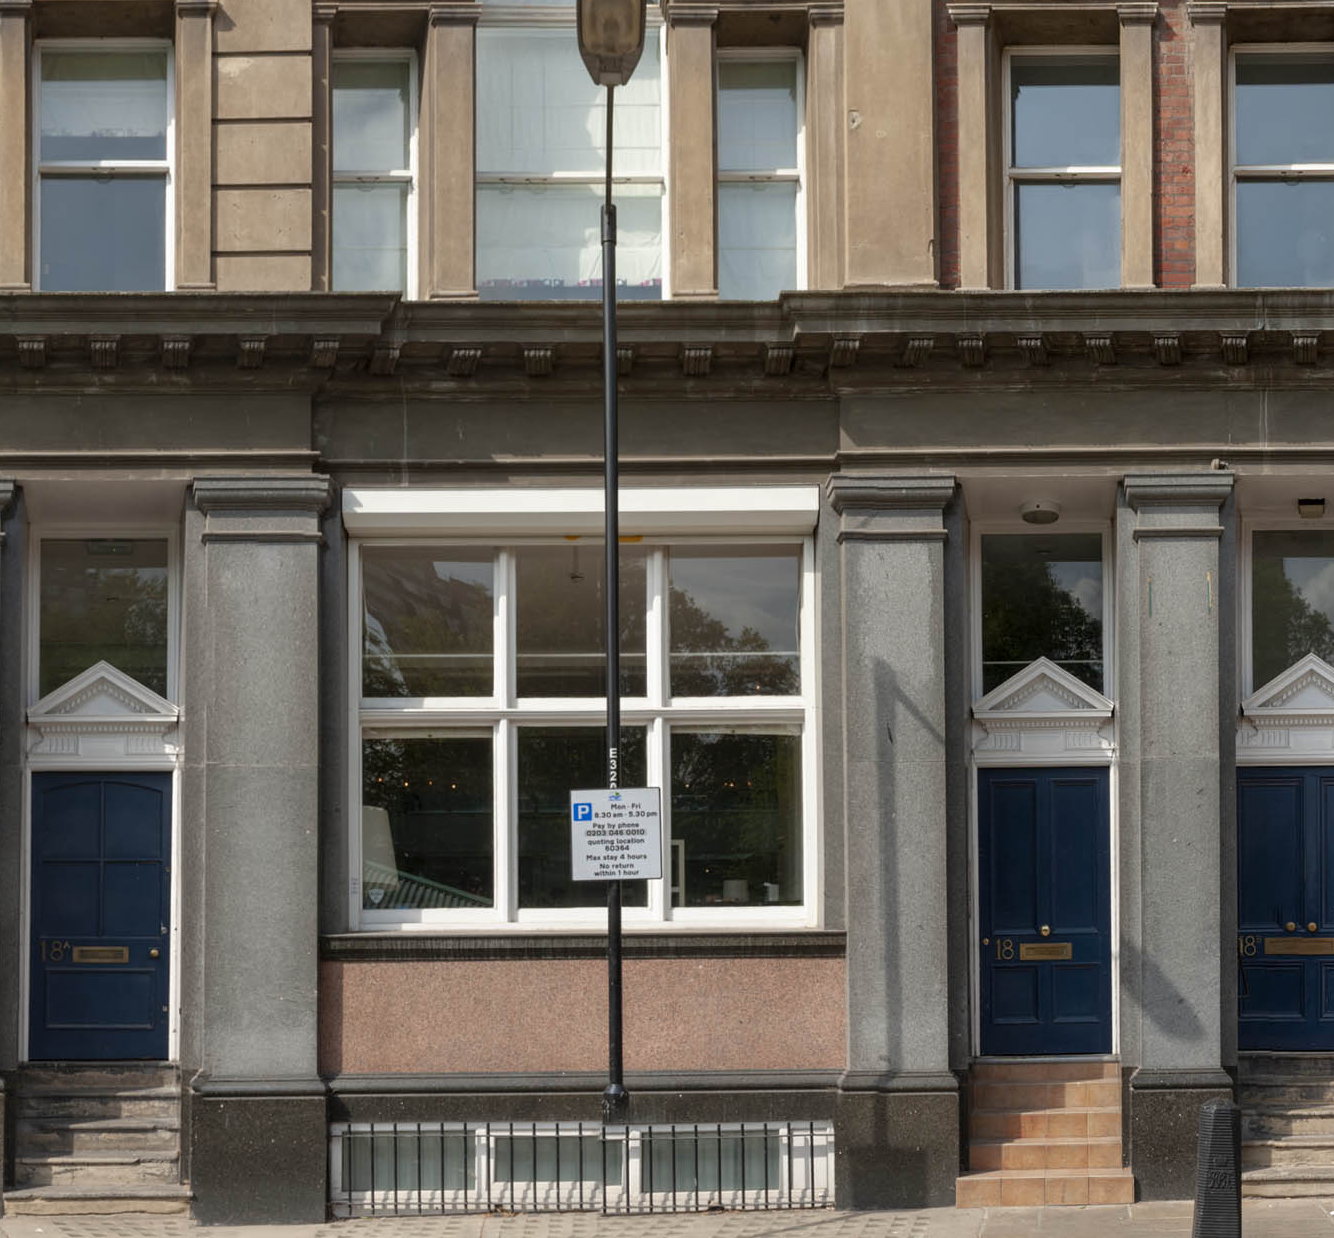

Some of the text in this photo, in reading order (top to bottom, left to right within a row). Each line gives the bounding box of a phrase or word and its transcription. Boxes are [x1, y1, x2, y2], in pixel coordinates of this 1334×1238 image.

[578, 804, 590, 820] P
[593, 822, 639, 830] Pay by phone
[996, 938, 1015, 960] 18
